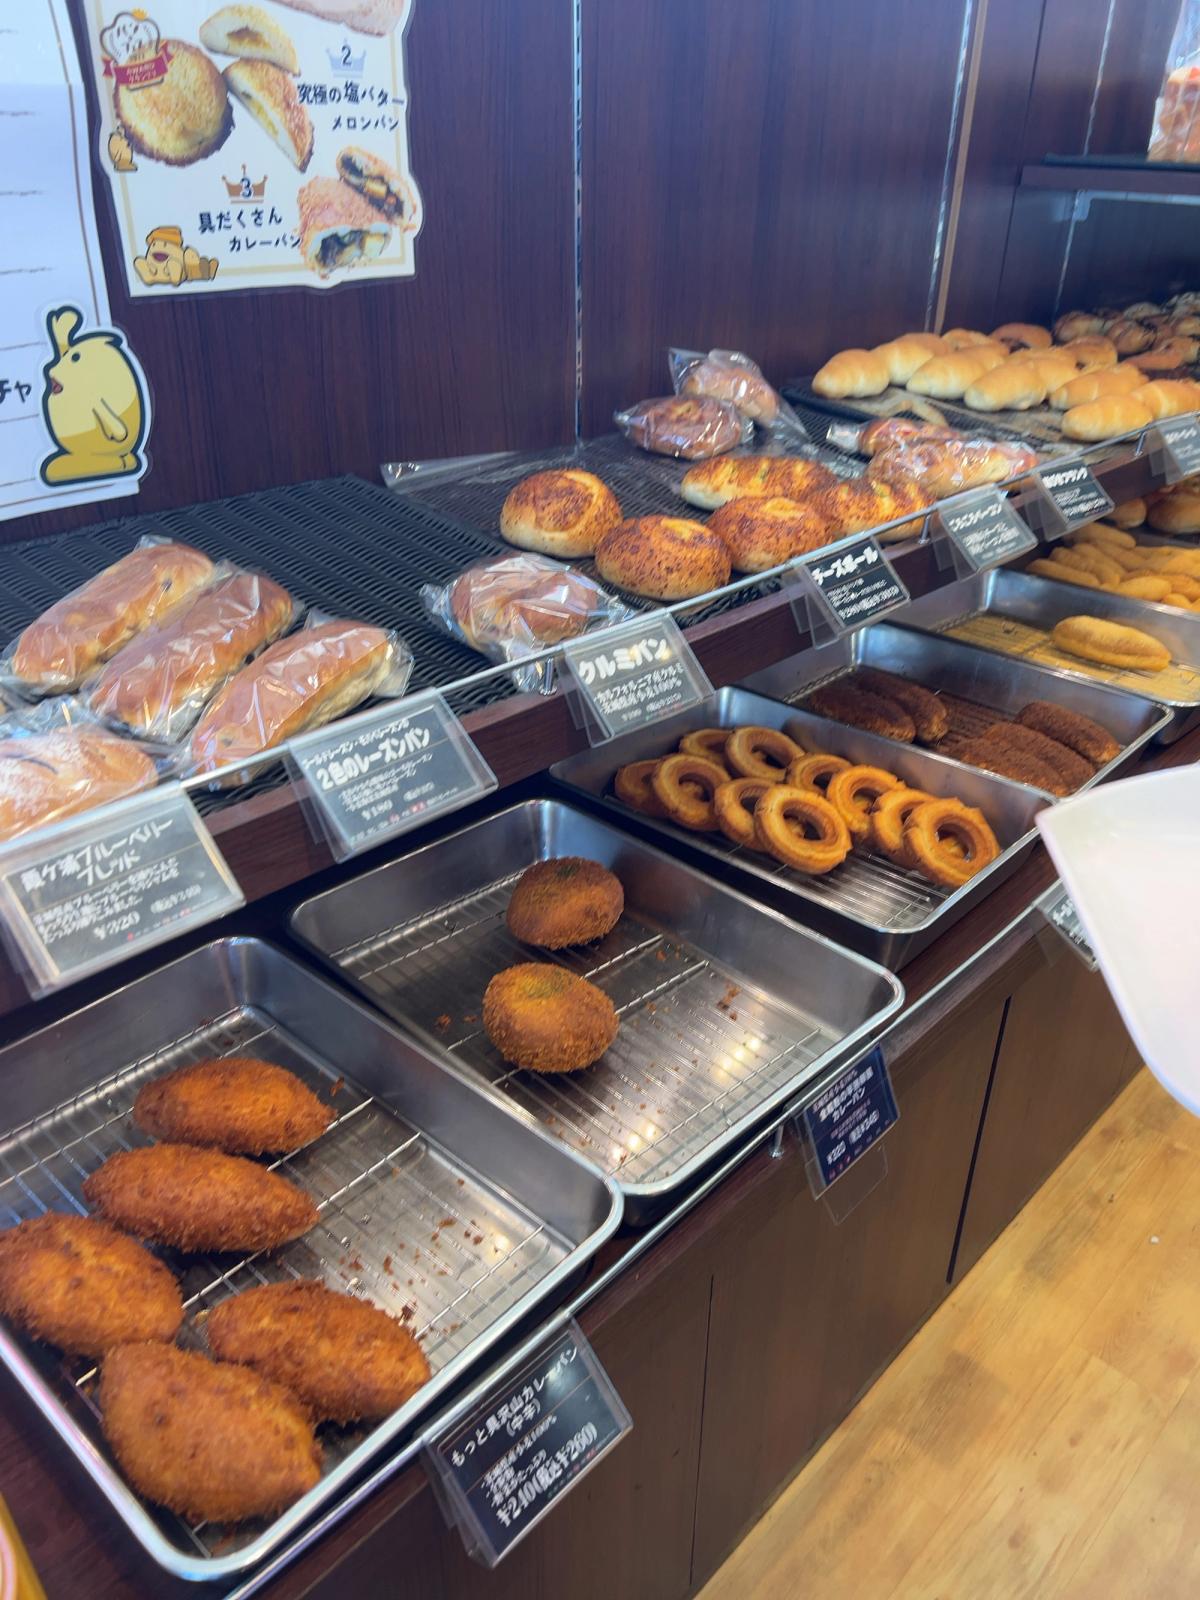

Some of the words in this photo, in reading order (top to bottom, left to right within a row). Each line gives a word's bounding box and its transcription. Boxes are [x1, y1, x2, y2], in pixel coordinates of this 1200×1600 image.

[340, 46, 352, 67] 2
[298, 83, 405, 107] 究極の塩バター
[331, 116, 399, 132] メロンパン
[240, 178, 252, 199] 3
[199, 208, 283, 233] 具だくさん
[229, 232, 302, 252] カレーパン
[578, 638, 670, 685] クルミパン
[316, 727, 430, 790] 2色のレーズンパン
[832, 1086, 866, 1122] カレーパン
[451, 1346, 577, 1467] もっと具沢山カレーパン
[506, 1398, 541, 1437] (中辛)
